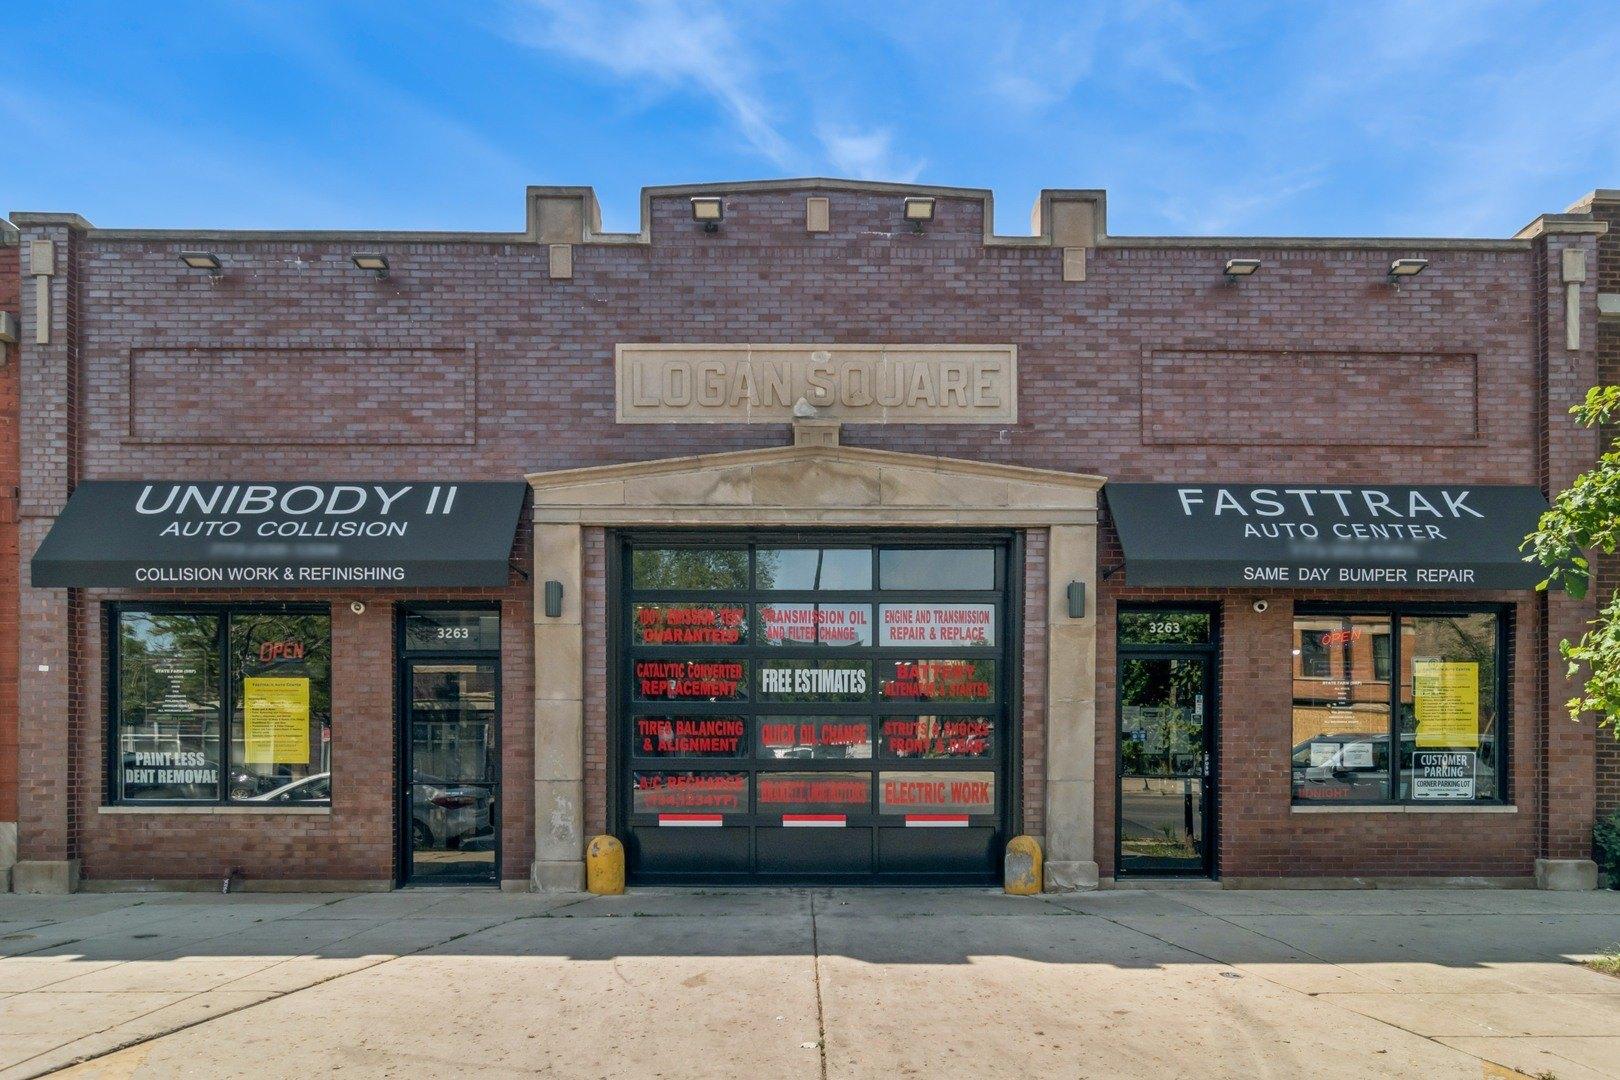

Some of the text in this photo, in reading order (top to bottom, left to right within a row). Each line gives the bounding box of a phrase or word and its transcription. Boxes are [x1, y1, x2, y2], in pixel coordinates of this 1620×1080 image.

[632, 360, 1001, 407] LOGAN SQUARE
[135, 485, 458, 515] UNIBODY II
[1177, 489, 1485, 518] FASTTRAK
[160, 521, 409, 537] AUTO COLLISION
[1244, 523, 1448, 540] AUTO CENTER
[135, 567, 405, 581] COLLISION WORK & REFINISHING
[1243, 566, 1475, 583] SAME DAY BUMPER REPAIR
[760, 608, 868, 625] TRANSMISSION OIL
[884, 609, 990, 624] ENGINE AND TRANSMISSION
[437, 627, 469, 639] 3263
[767, 626, 855, 640] AND FILTER CHANGE
[889, 627, 985, 640] REPAIR & REPLACE
[1149, 622, 1180, 633] 3263
[259, 642, 304, 661] OPEN
[637, 663, 743, 678] CATALYTIC CONVERTER
[763, 668, 867, 693] FREE ESTIMATES
[641, 681, 737, 696] REPLACEMENT
[676, 721, 744, 736] BALANCING
[762, 723, 868, 745] QUICK OIL CHANGE
[643, 738, 738, 752] & ALIGNMENT
[135, 752, 205, 766] PAINT LESS
[1420, 754, 1468, 766] CUSTOMER
[125, 769, 218, 784] DENT REMOVAL
[1424, 766, 1463, 777] PARKING
[884, 782, 946, 804] ELECTRIC
[951, 782, 990, 804] WORK
